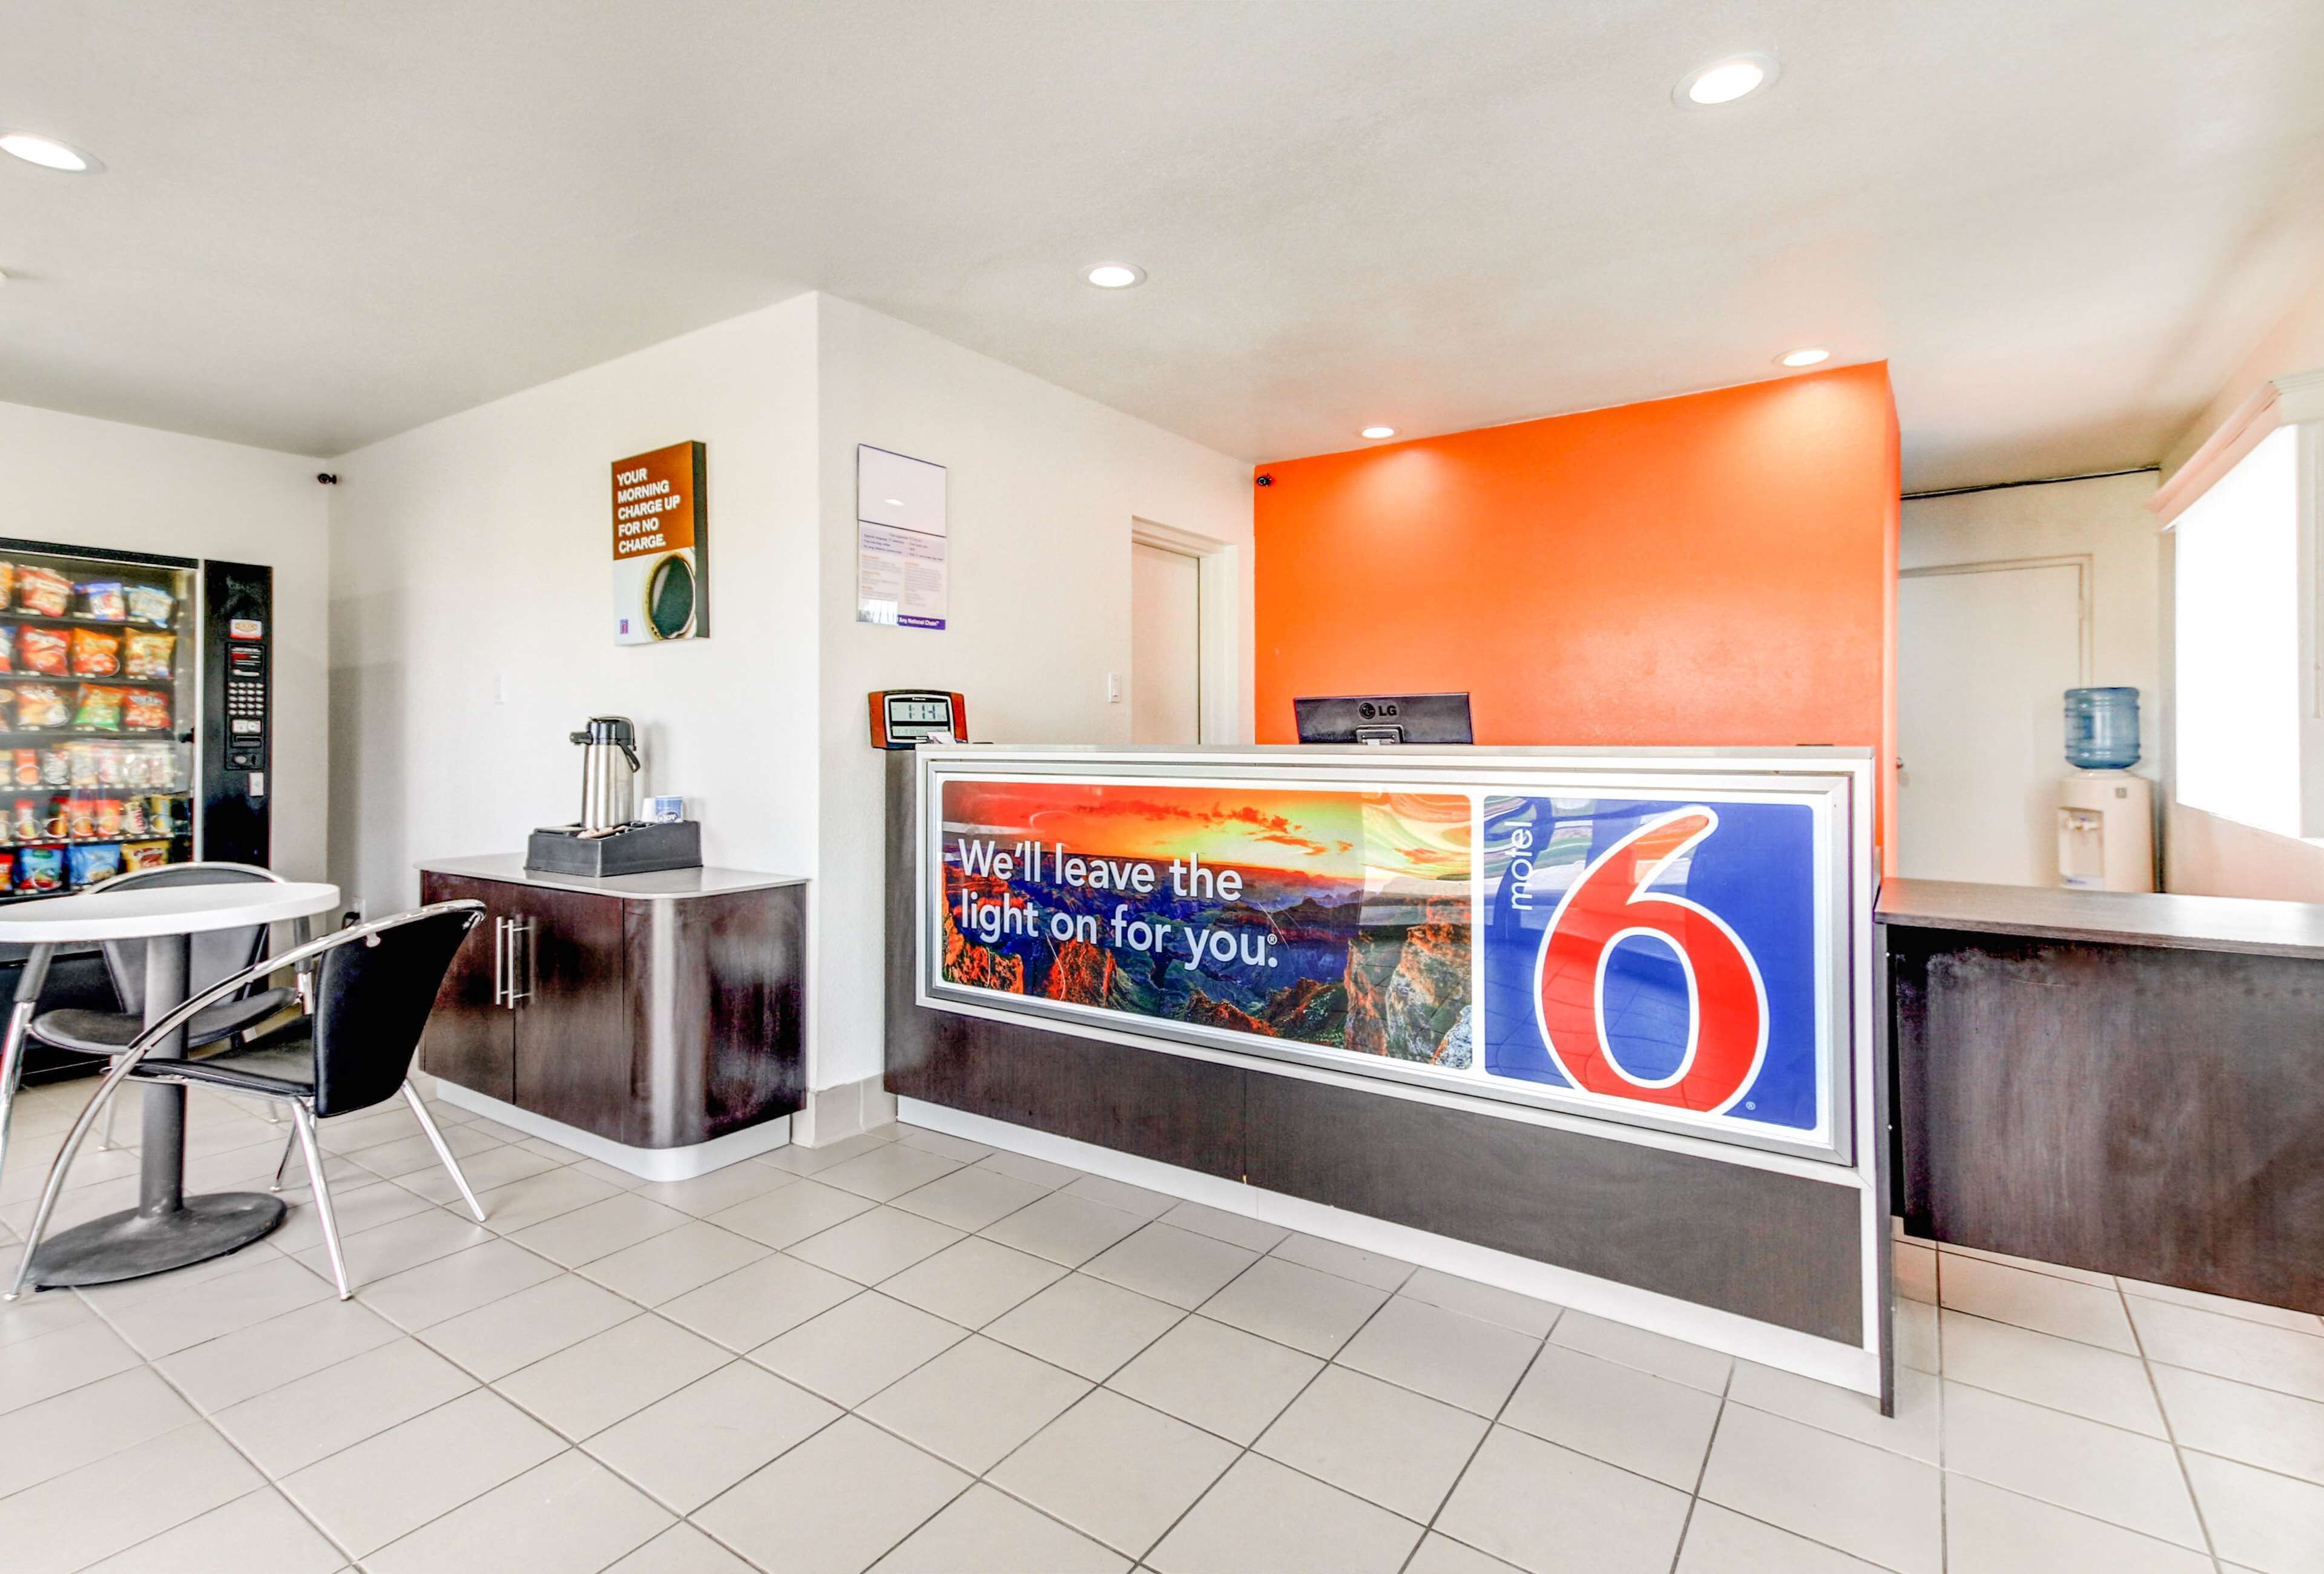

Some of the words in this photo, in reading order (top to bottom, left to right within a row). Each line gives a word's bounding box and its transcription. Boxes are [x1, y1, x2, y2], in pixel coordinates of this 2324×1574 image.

[617, 468, 647, 486] YOUR
[617, 479, 670, 504] MORNING
[618, 499, 663, 520] CHARGE
[664, 495, 680, 510] UP
[619, 521, 640, 537] FOR
[642, 517, 659, 532] NO
[619, 533, 666, 554] CHARGE.
[1378, 705, 1397, 716] LG
[958, 838, 1041, 883] We'll
[1055, 842, 1155, 893] leave
[1168, 852, 1243, 901] the
[1504, 821, 1533, 910] motel
[961, 888, 1039, 943] light
[1050, 911, 1097, 944] on
[1110, 904, 1171, 953] for
[1534, 805, 1769, 1116] 6
